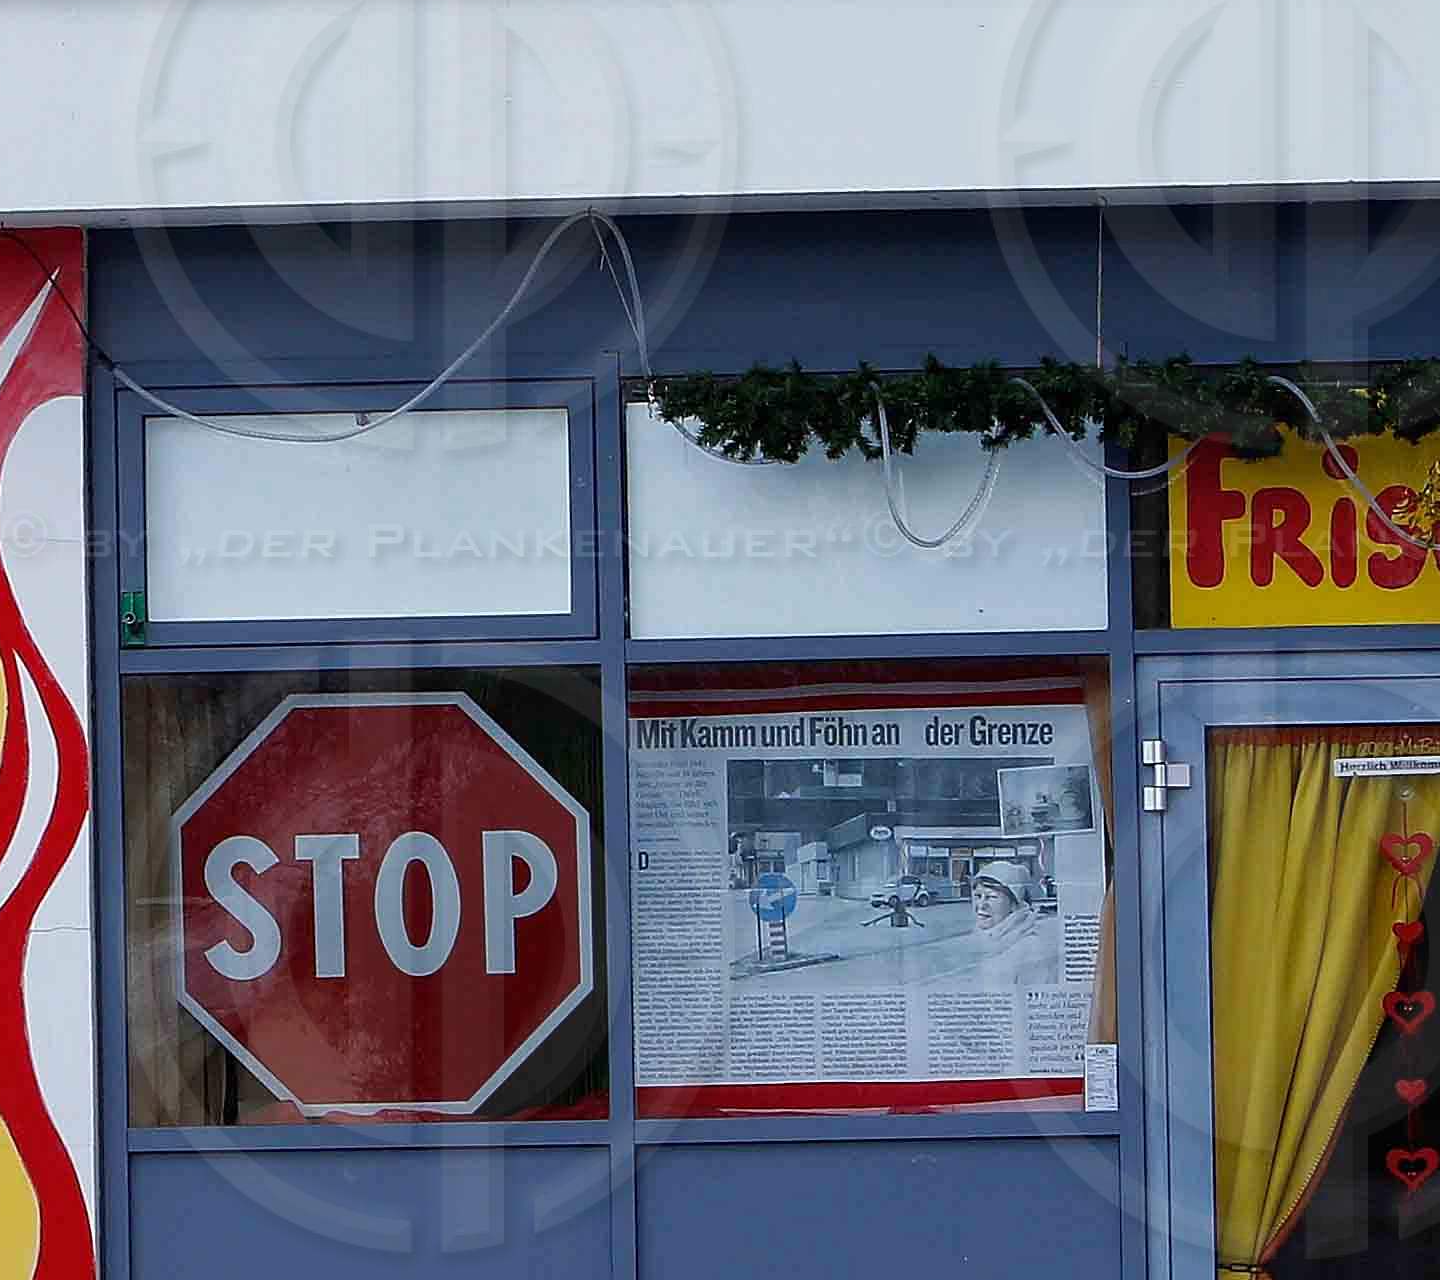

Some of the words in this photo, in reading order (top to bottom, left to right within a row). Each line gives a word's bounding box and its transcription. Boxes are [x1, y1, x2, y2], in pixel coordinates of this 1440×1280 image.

[637, 719, 678, 750] Mit
[680, 718, 756, 749] Kamm
[762, 717, 806, 747] und
[810, 713, 869, 747] Föhn
[872, 722, 900, 746] an
[926, 716, 965, 745] der
[969, 714, 1054, 746] Grenze
[204, 831, 558, 981] STOP
